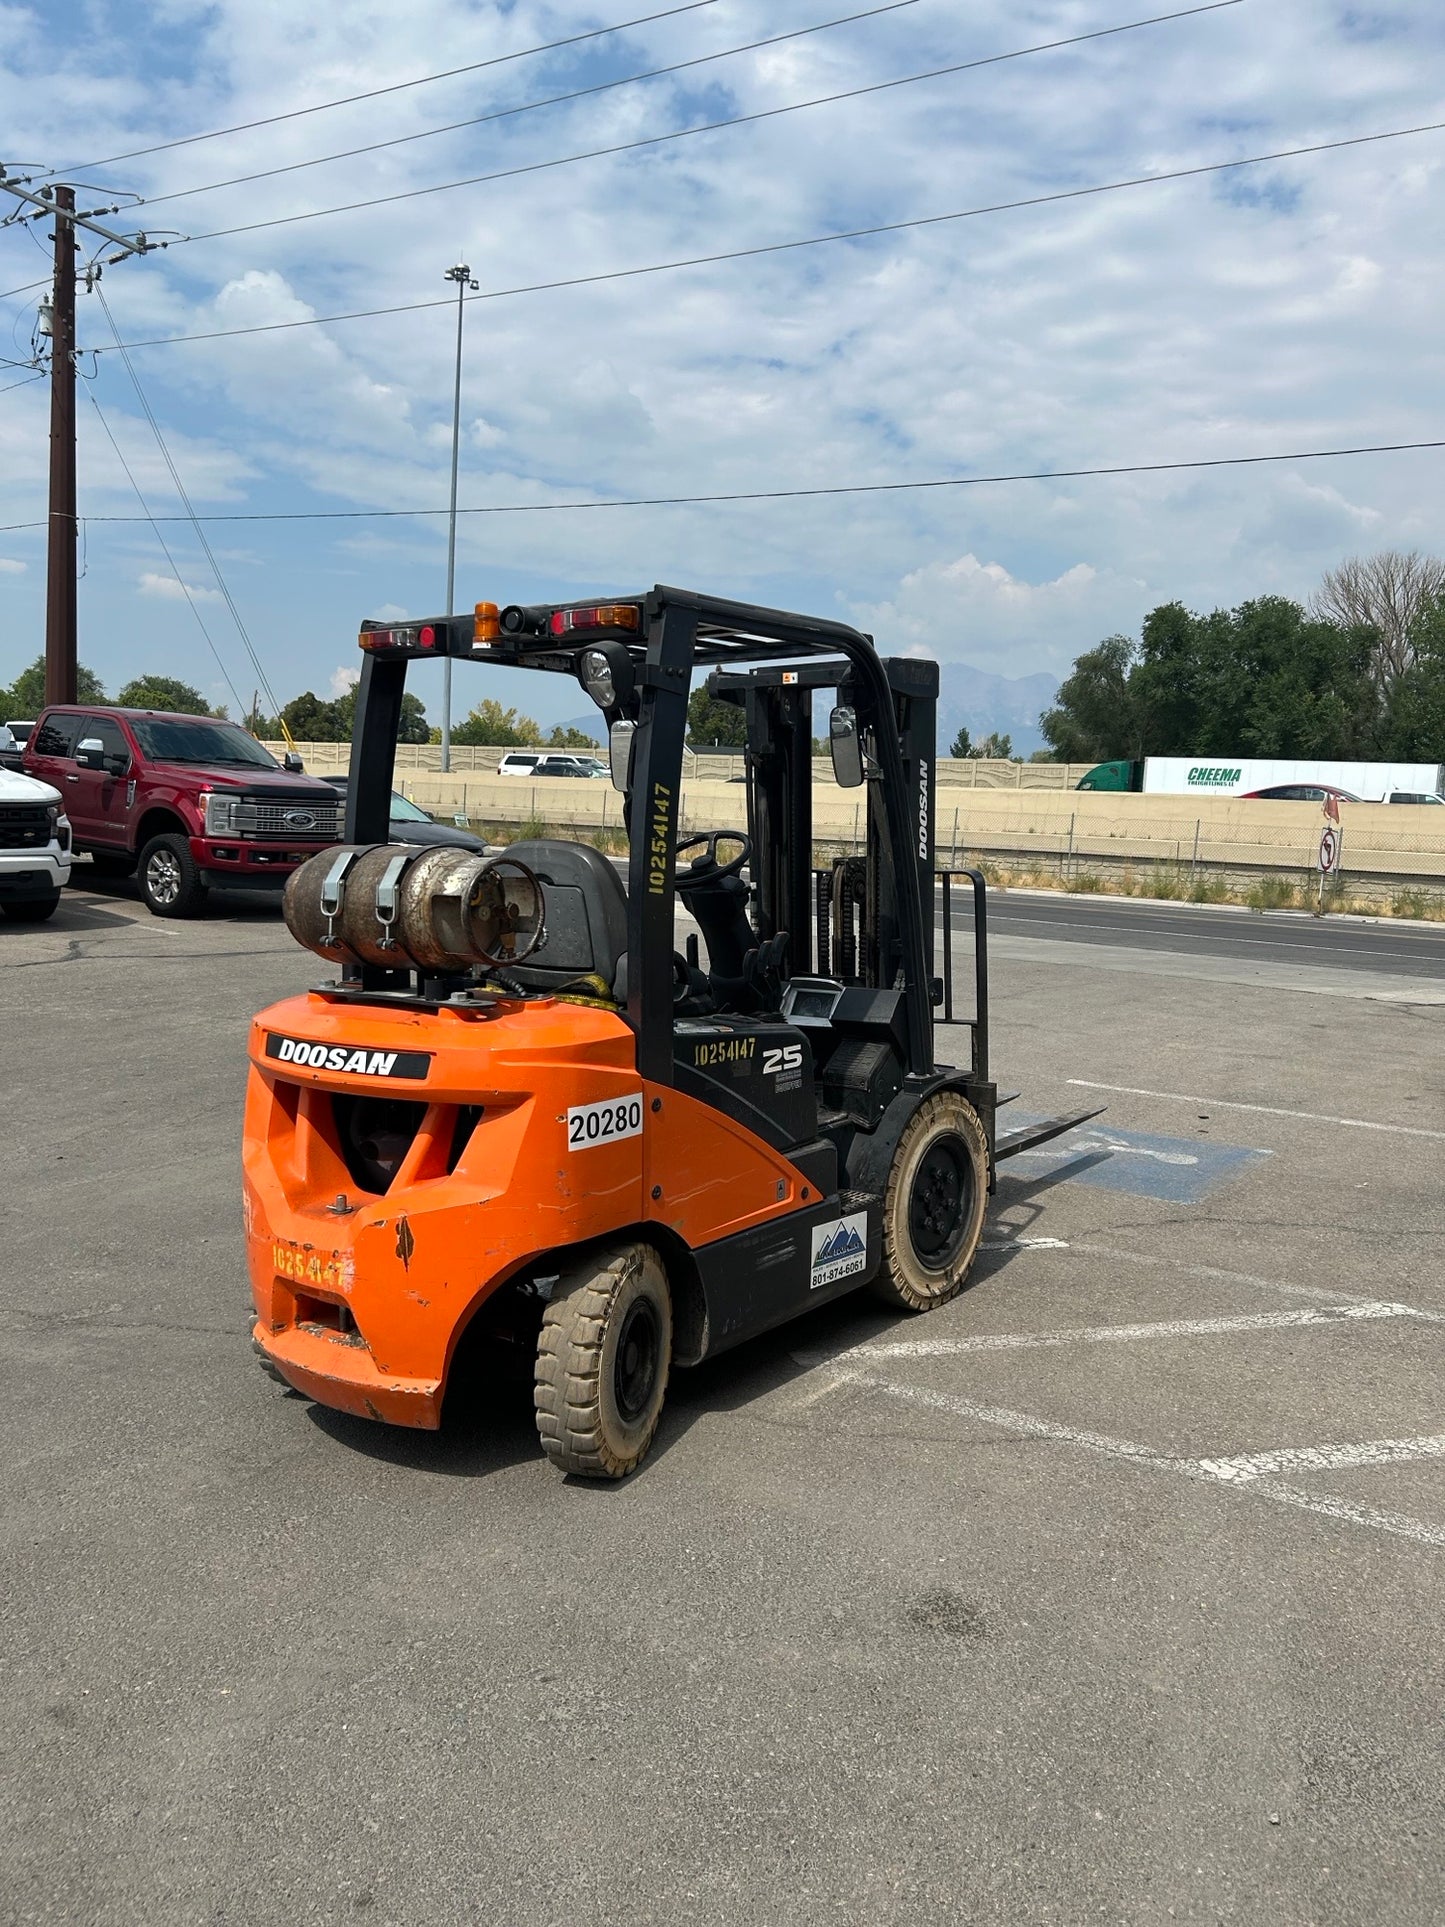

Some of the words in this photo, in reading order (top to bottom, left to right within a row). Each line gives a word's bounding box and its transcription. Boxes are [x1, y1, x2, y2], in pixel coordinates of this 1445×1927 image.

[1187, 767, 1242, 781] CHEEMA
[919, 759, 928, 860] DOOSAN
[649, 782, 671, 894] 10254147
[278, 1038, 398, 1076] DOOSAN
[694, 1038, 756, 1066] 10254147
[762, 1044, 803, 1075] 25
[569, 1101, 641, 1143] 20280
[812, 1259, 863, 1286] 801-874-6061
